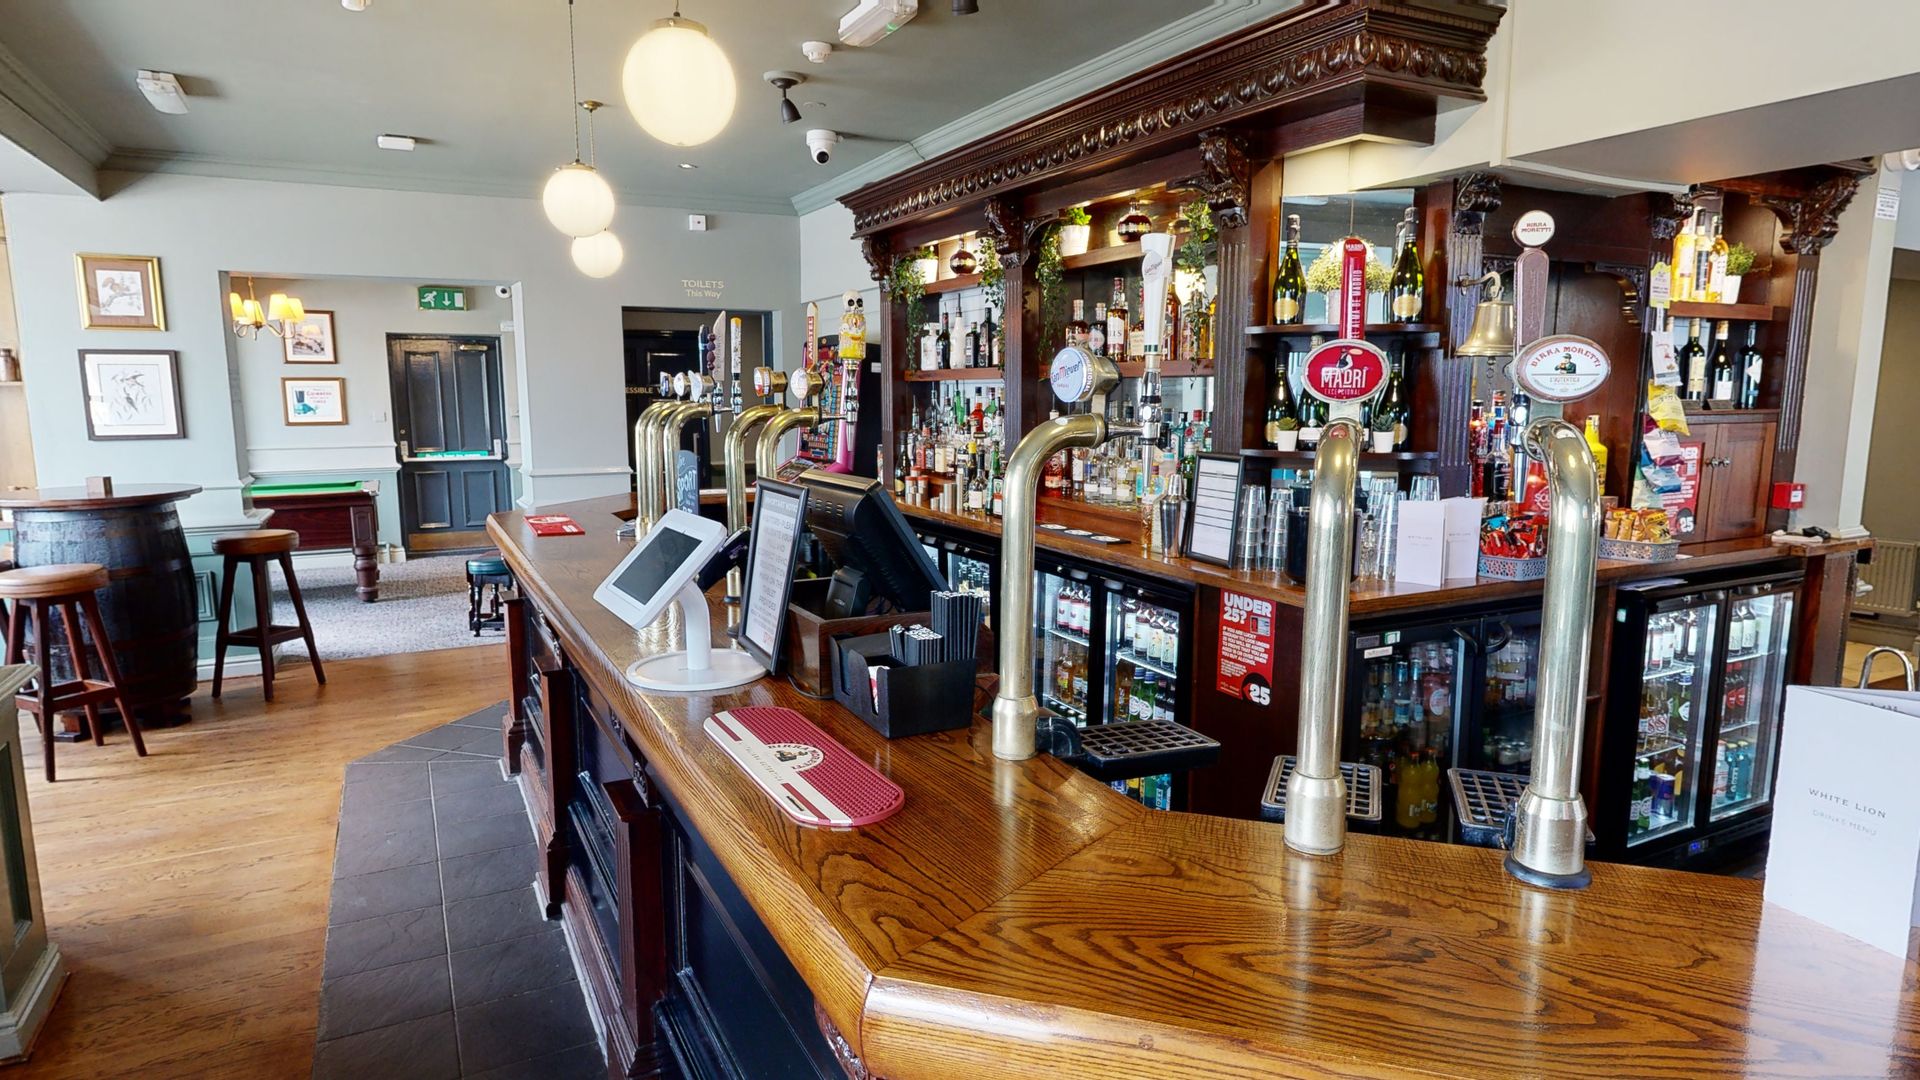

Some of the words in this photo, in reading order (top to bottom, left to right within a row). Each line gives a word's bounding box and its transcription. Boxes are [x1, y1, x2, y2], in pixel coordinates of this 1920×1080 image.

[681, 279, 725, 289] TOILETS
[1351, 269, 1362, 297] MADRID
[685, 289, 703, 297] This
[703, 290, 722, 300] Way
[1531, 347, 1560, 368] BIRRA
[1563, 346, 1601, 368] MORETTI
[1679, 515, 1695, 533] 25
[1224, 591, 1272, 618] UNDER
[1223, 606, 1247, 625] 25?
[1249, 683, 1270, 706] 25
[1808, 787, 1849, 807] WHITE
[1855, 802, 1887, 819] LION
[1849, 821, 1877, 837] MENU
